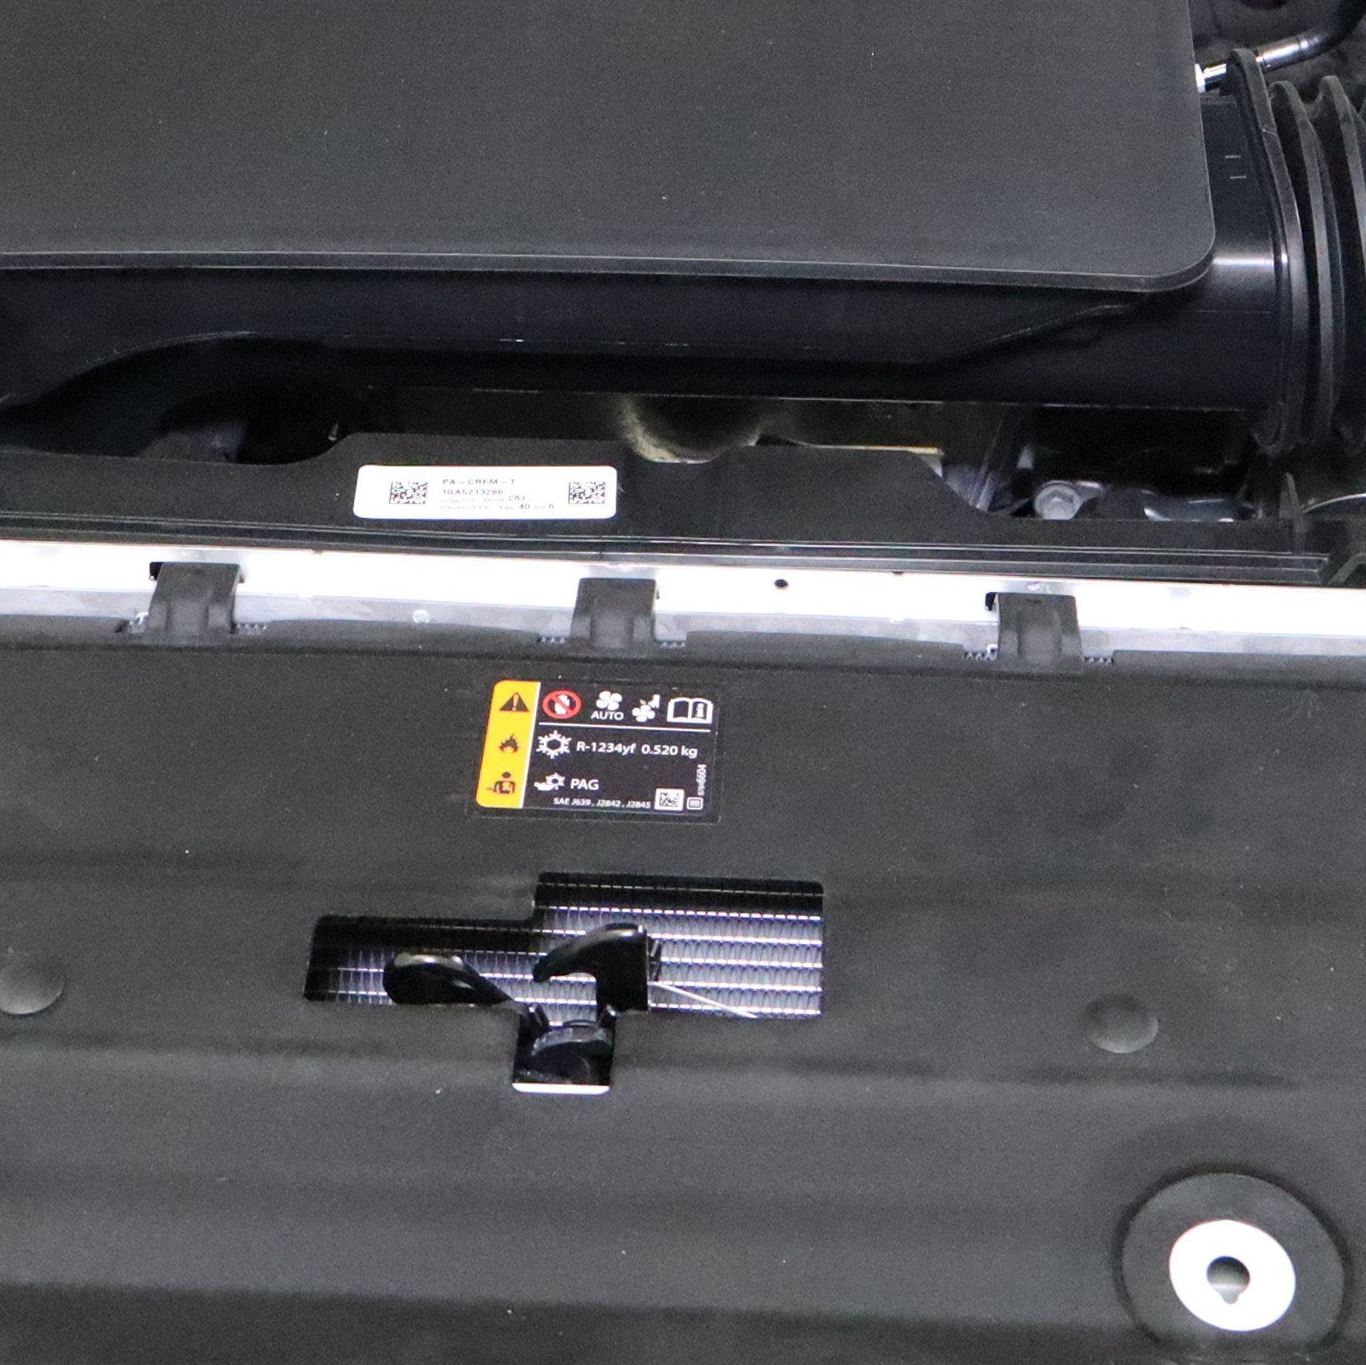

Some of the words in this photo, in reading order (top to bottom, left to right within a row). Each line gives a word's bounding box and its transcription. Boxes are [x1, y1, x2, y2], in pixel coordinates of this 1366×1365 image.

[590, 710, 624, 721] AUTO
[576, 741, 637, 756] R-1234yf
[641, 744, 678, 756] 0.520
[681, 745, 698, 759] kg
[570, 777, 600, 791] PAG
[553, 797, 570, 806] SAE
